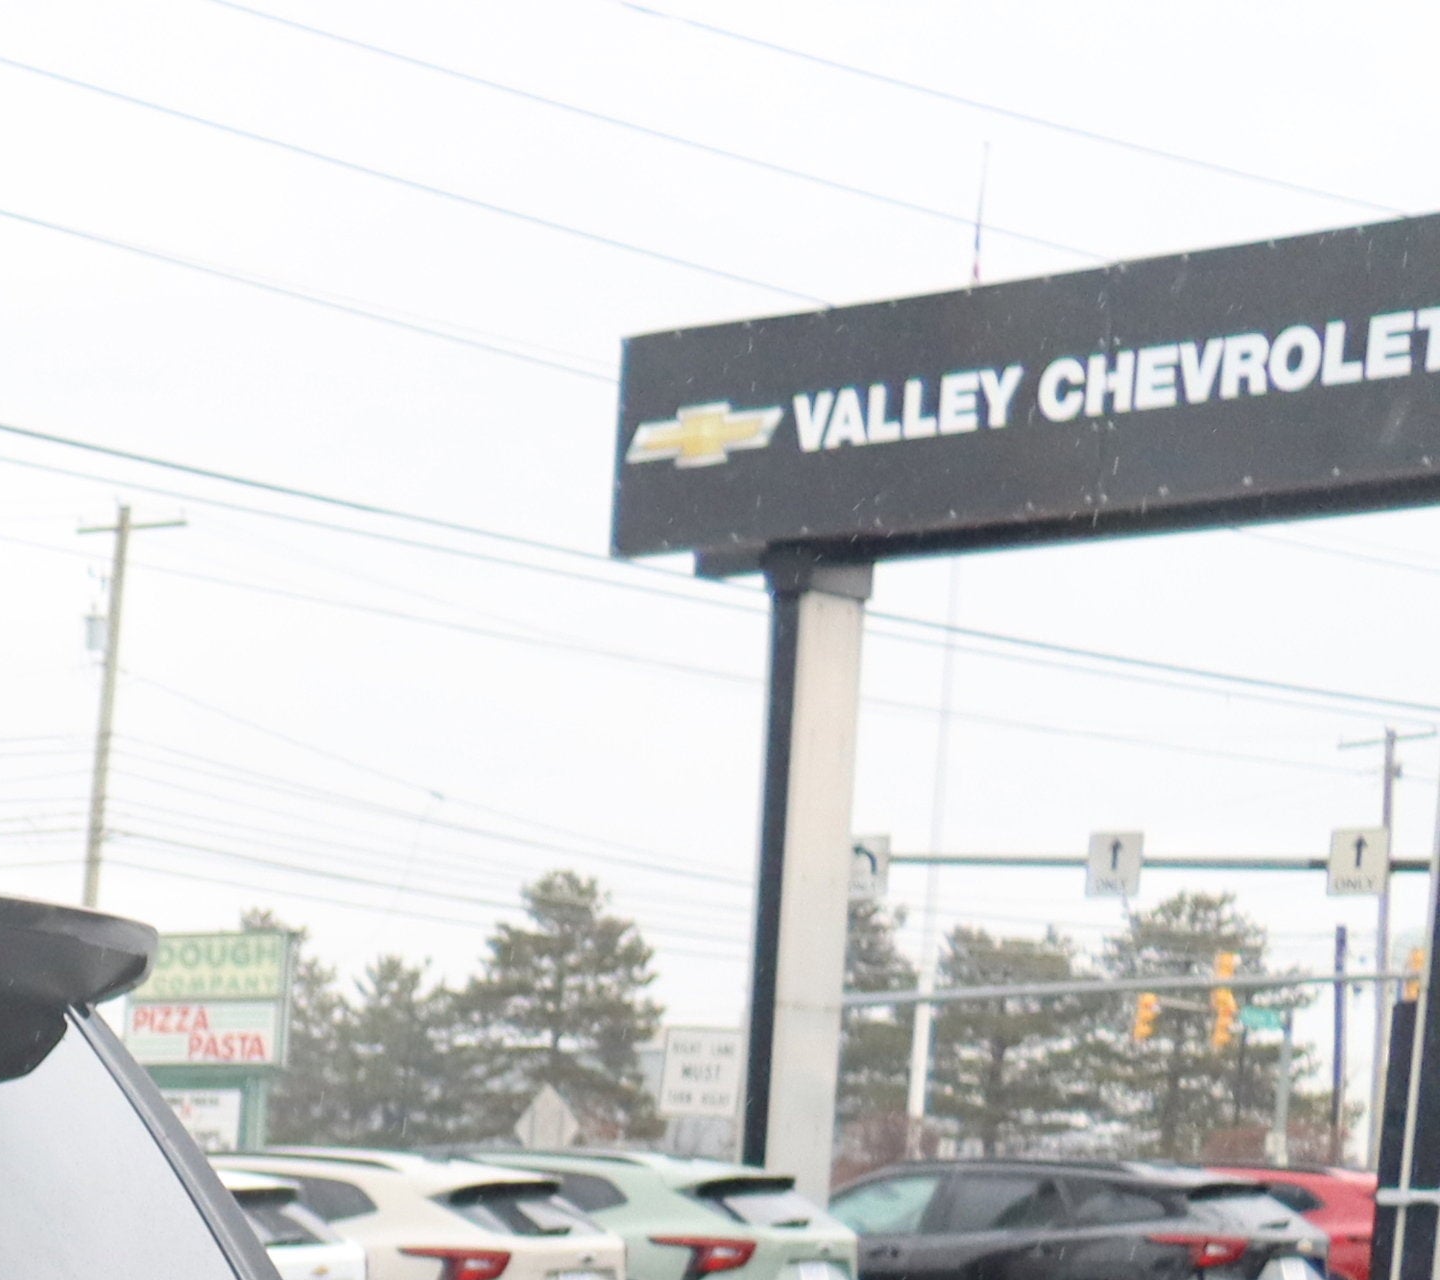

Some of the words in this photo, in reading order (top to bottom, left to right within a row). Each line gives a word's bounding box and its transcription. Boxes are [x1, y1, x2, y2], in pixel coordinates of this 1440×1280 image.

[791, 365, 1022, 452] VALLEY
[1334, 876, 1377, 891] ONLY
[156, 940, 278, 969] DOUGH
[153, 976, 278, 991] COMPANY
[133, 1005, 209, 1034] PIZZA
[188, 1033, 267, 1061] PASTA
